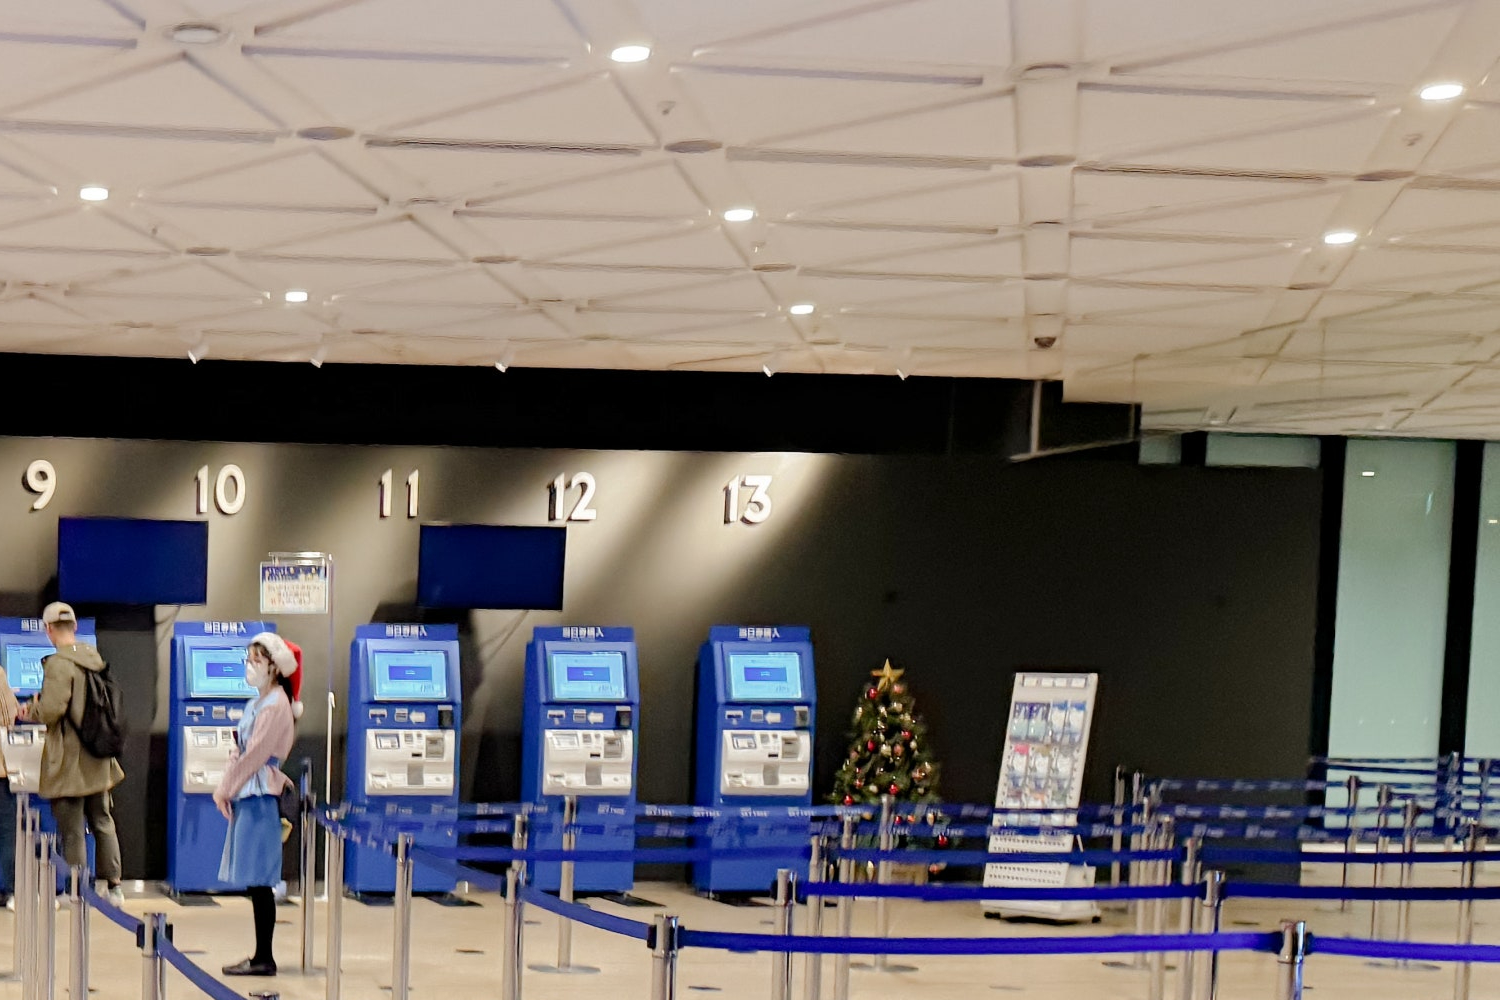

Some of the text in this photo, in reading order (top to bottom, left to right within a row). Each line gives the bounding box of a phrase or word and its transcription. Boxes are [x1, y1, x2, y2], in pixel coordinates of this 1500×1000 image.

[25, 459, 57, 511] 9
[196, 463, 247, 515] 10
[379, 468, 419, 518] 11
[547, 472, 597, 521] 12
[723, 475, 773, 524] 13
